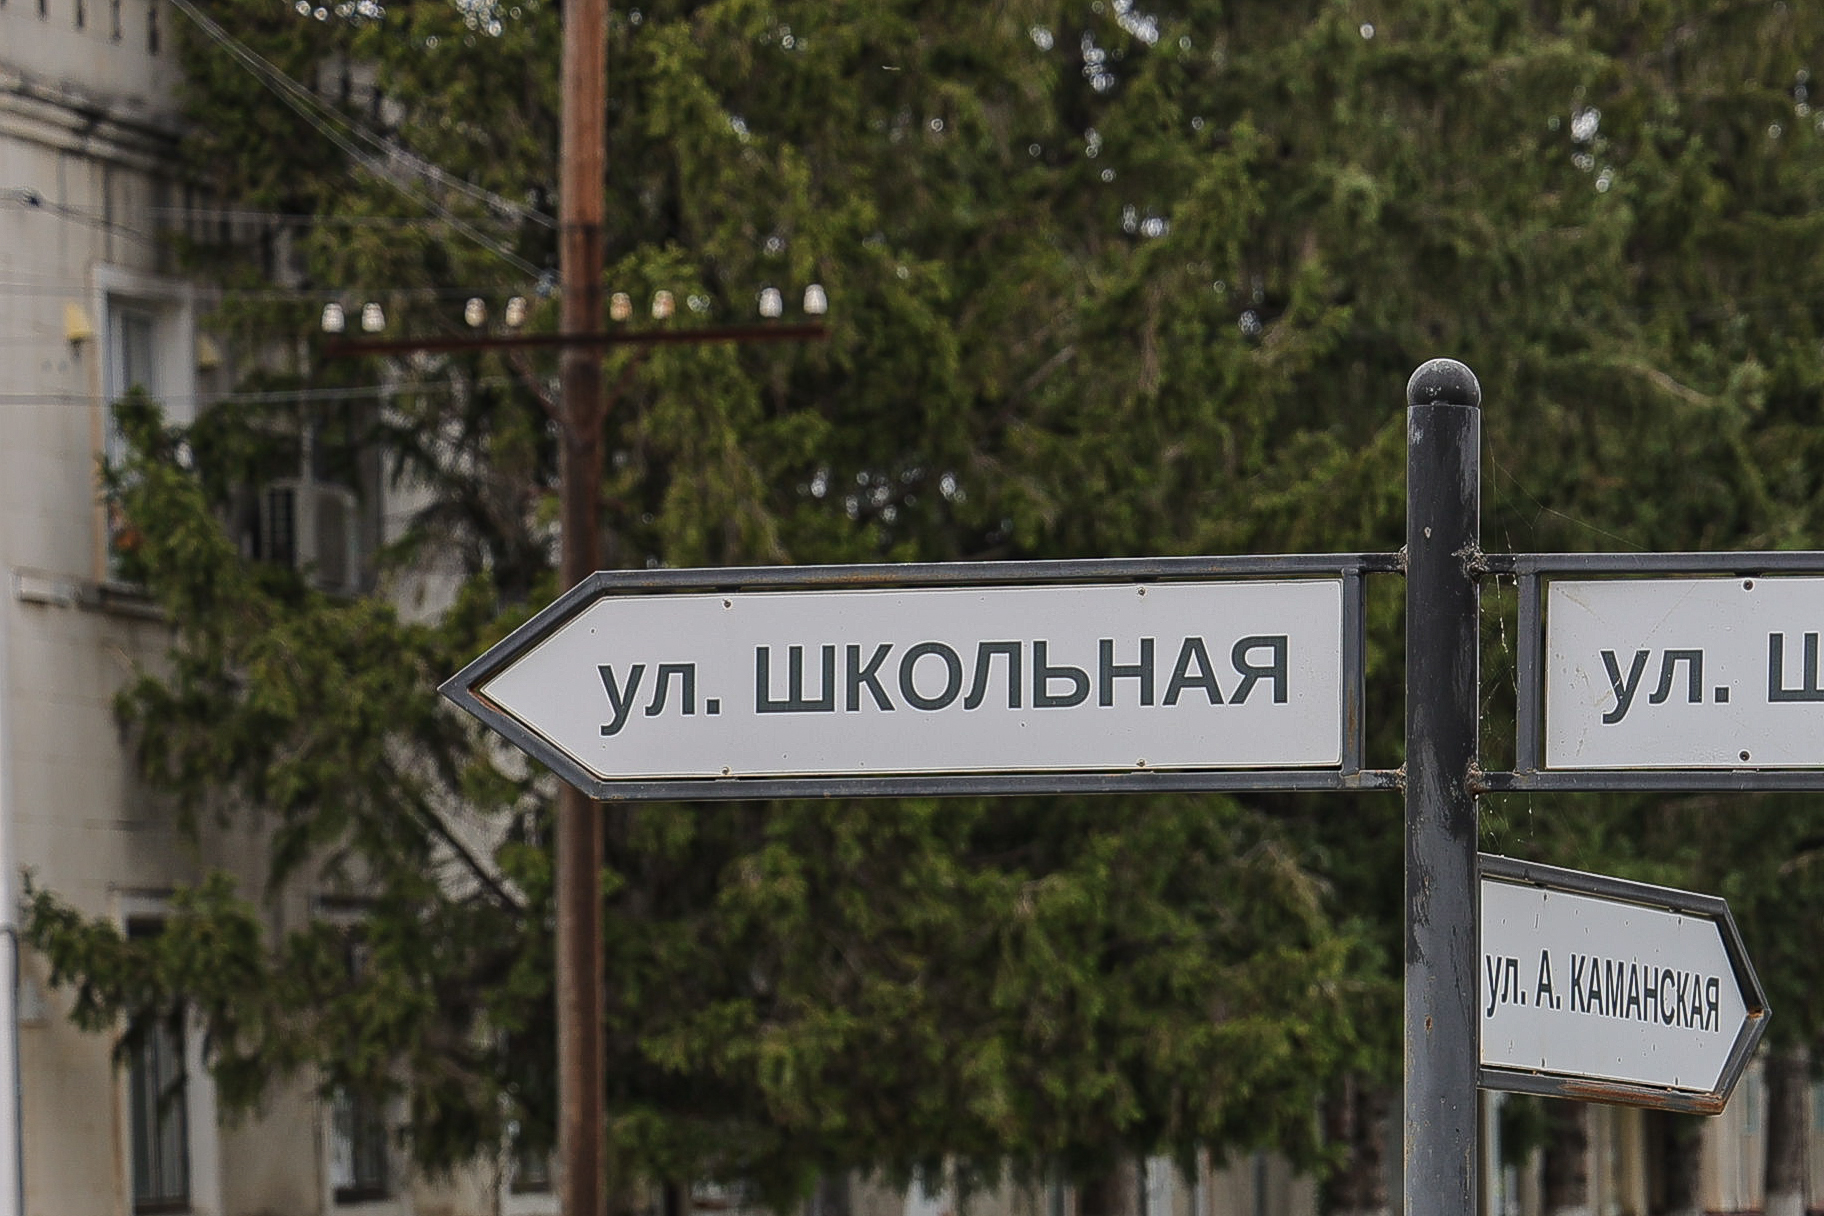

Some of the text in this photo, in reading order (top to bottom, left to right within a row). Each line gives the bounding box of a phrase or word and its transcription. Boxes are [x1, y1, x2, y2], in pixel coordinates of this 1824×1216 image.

[597, 635, 1288, 737] ул. ШКОЛЬНАЯ
[1600, 649, 1730, 725] ул.
[1485, 949, 1720, 1033] ул. А. КАМАНСКАЯ
